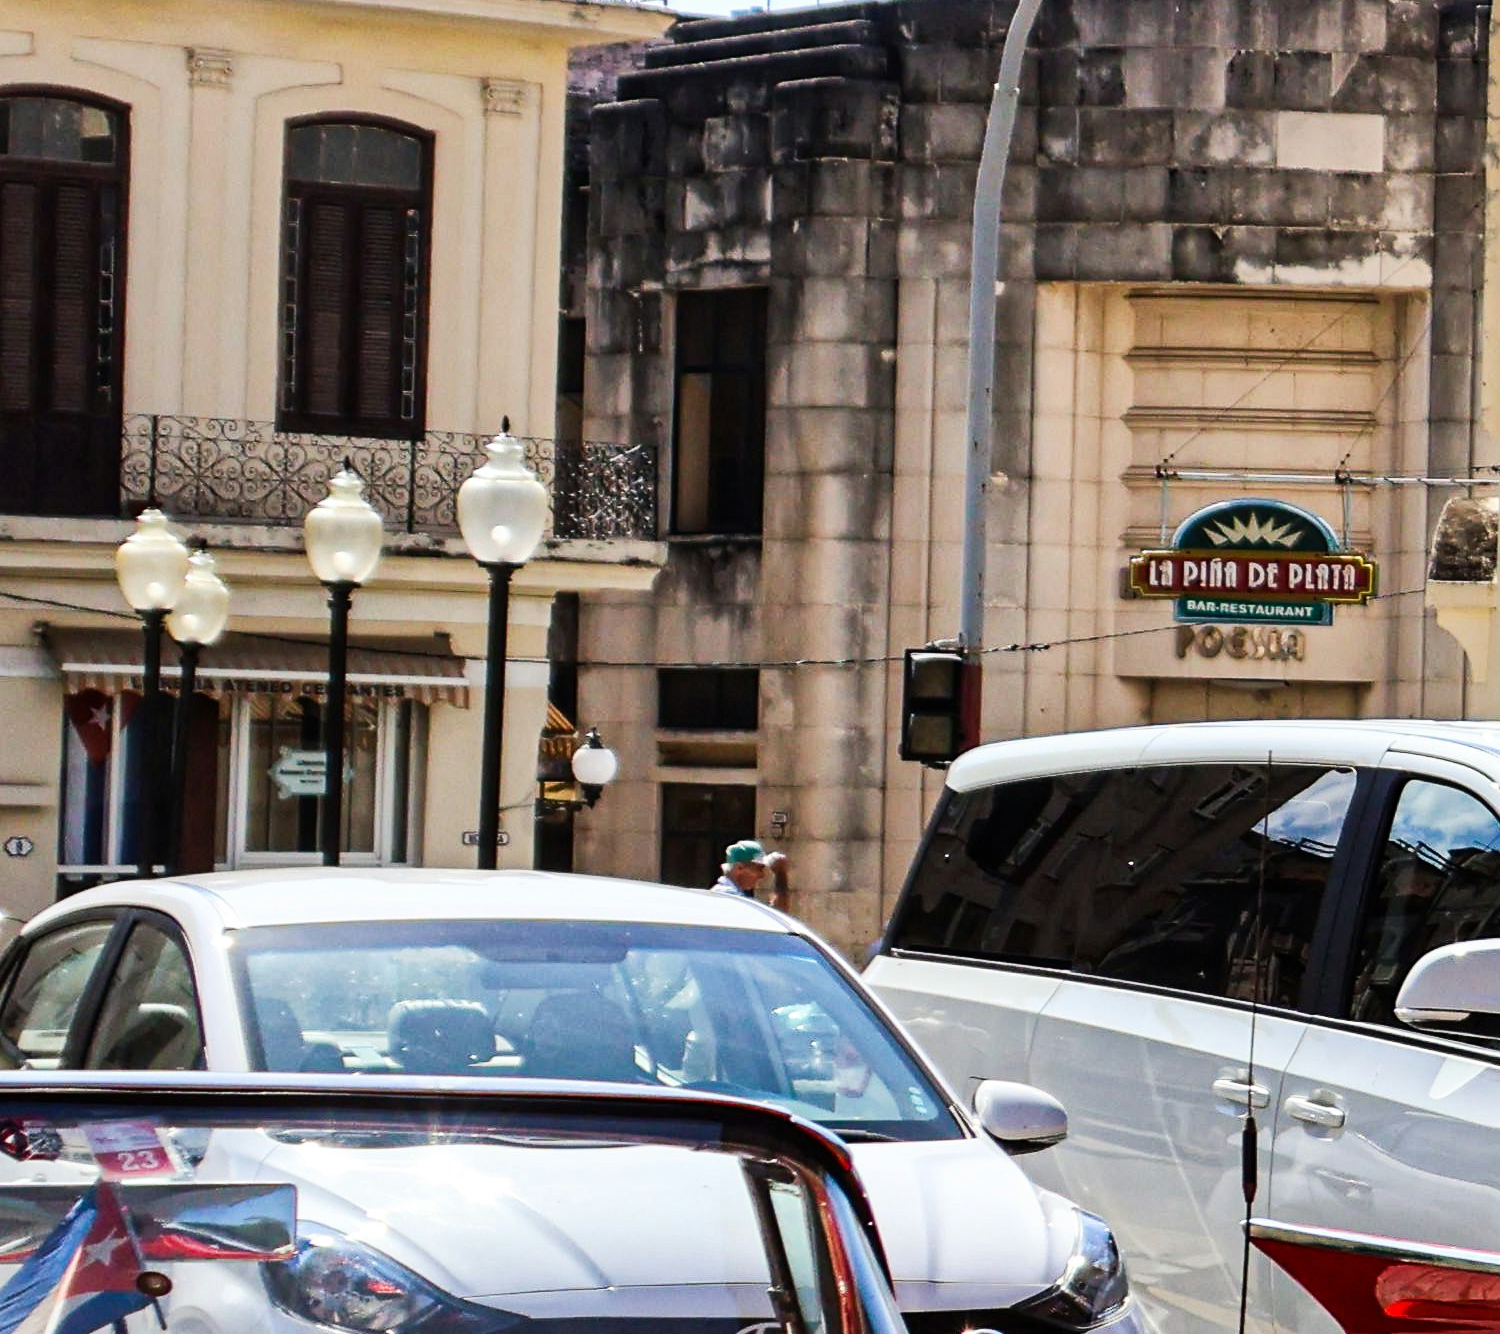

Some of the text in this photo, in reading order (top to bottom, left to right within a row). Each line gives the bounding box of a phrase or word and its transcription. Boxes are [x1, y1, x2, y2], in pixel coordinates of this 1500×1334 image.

[1149, 557, 1356, 591] LA PIÑA DE PLATA
[1186, 599, 1314, 617] BAR-RESTAURANT
[303, 681, 405, 698] CEANTES
[117, 1150, 160, 1172] 23
